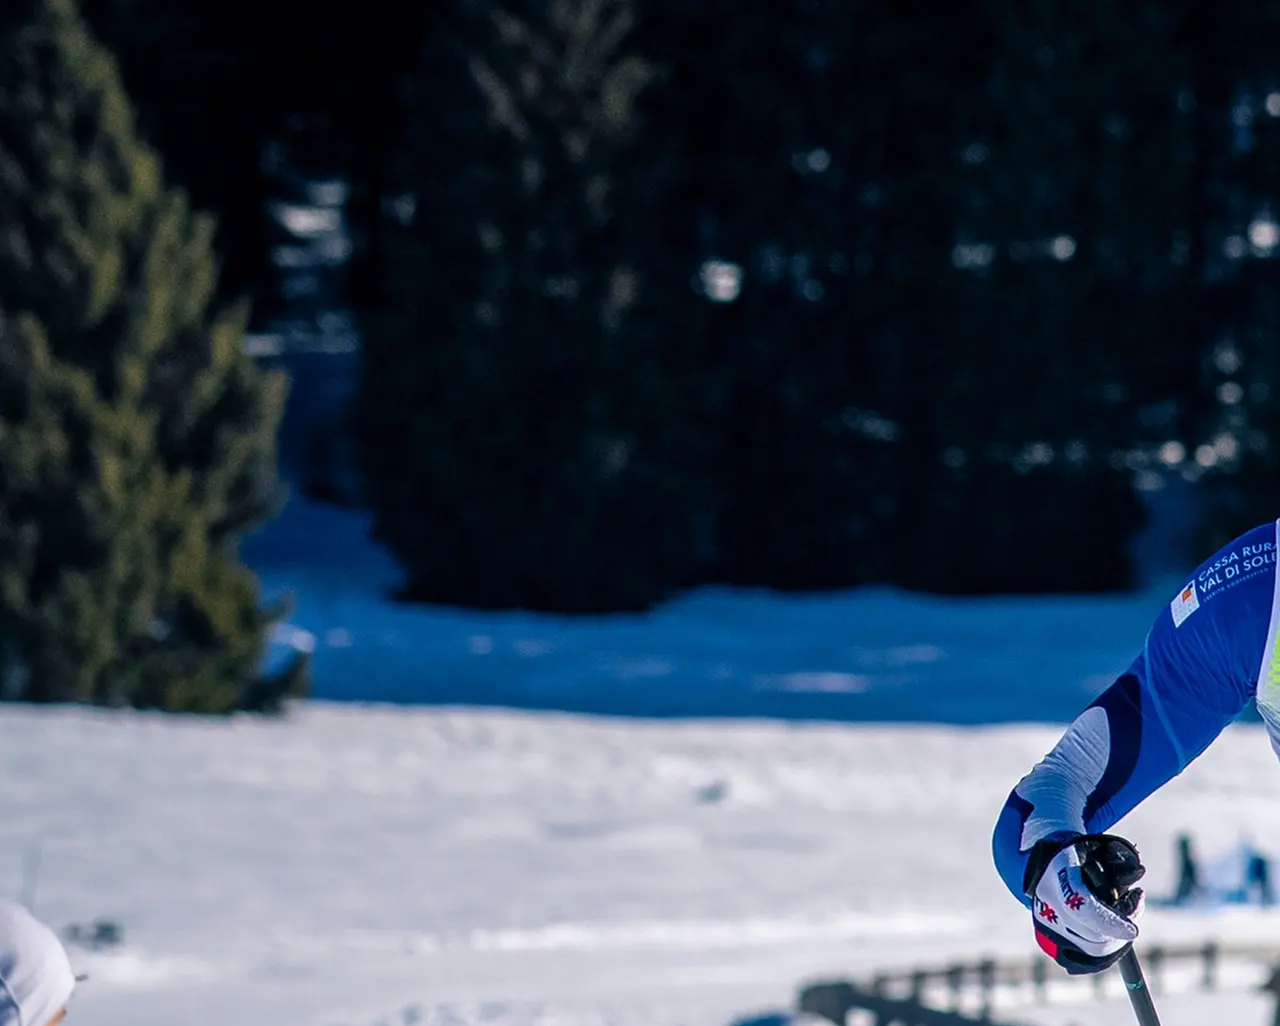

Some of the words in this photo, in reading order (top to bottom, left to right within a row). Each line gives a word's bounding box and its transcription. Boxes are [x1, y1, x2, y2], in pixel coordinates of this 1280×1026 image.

[1199, 552, 1239, 581] CASSA
[1199, 564, 1222, 592] VAL
[1225, 564, 1239, 579] DI
